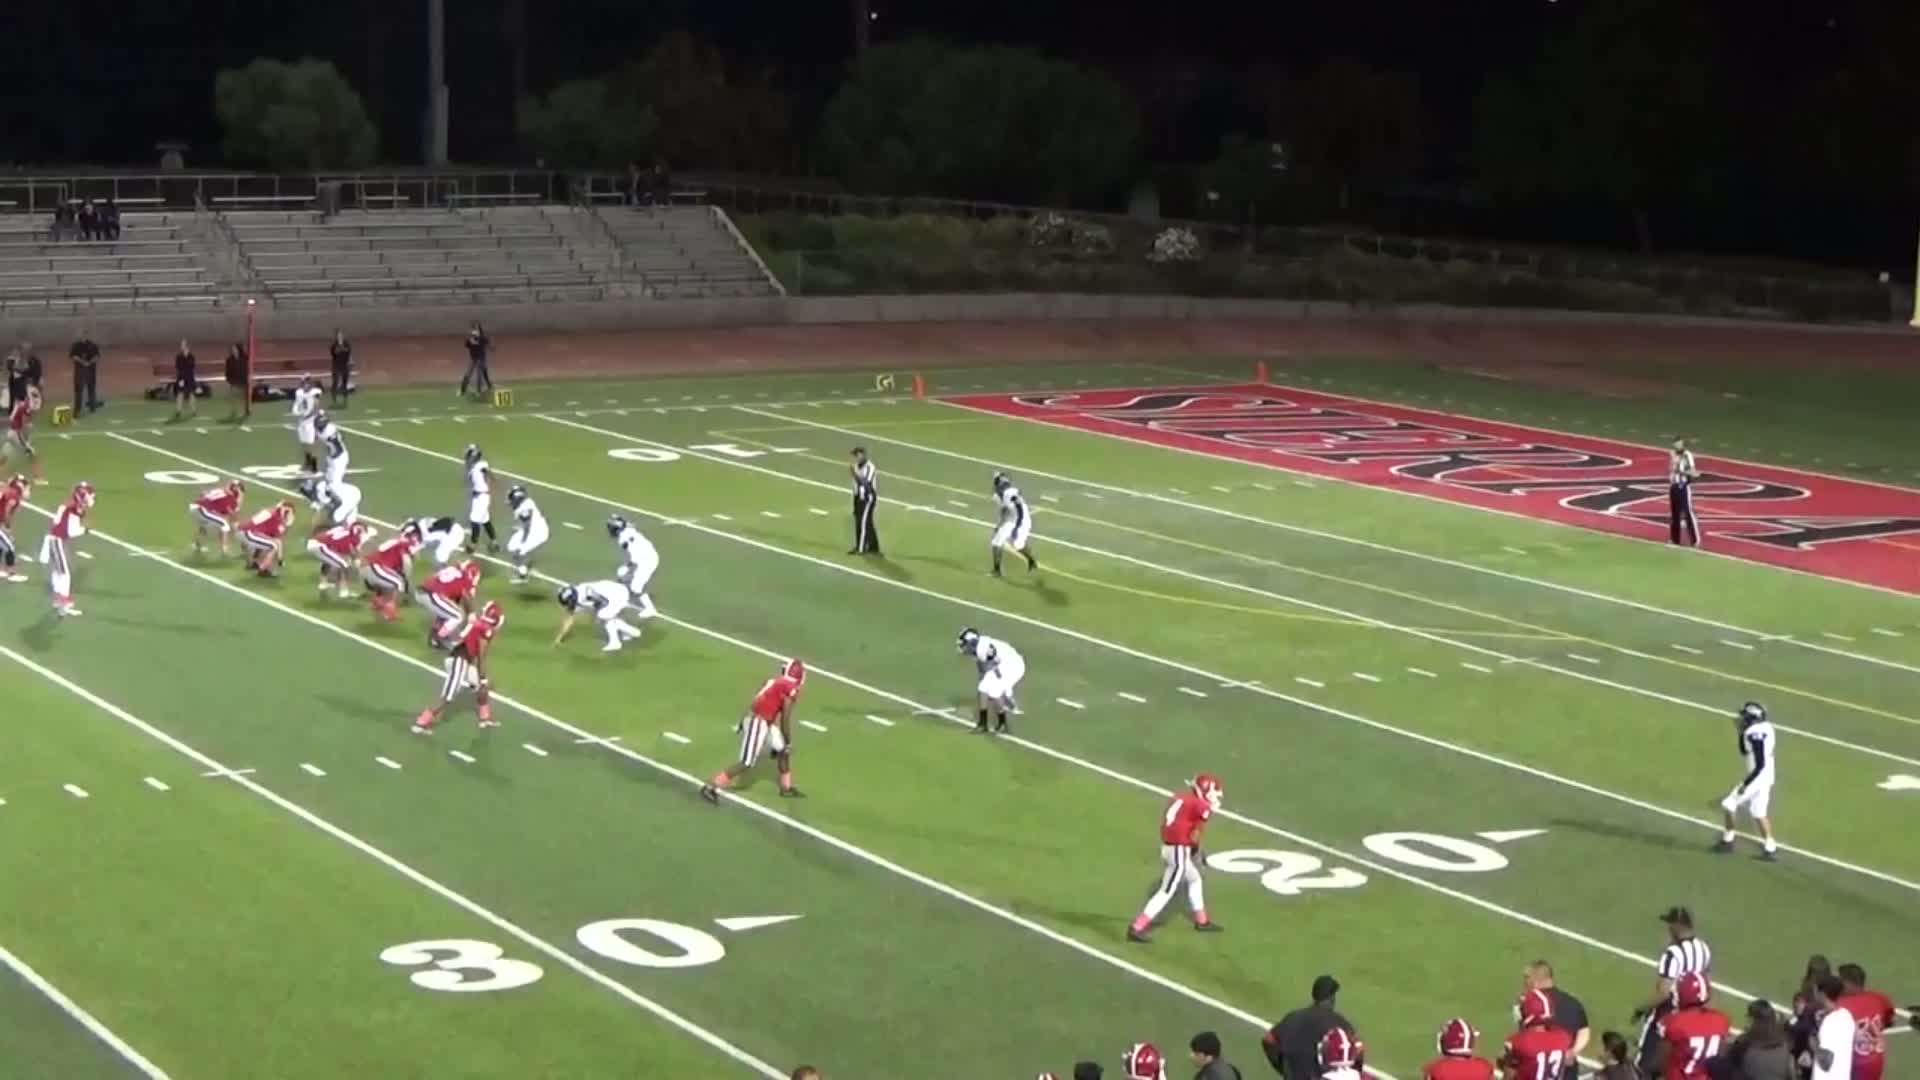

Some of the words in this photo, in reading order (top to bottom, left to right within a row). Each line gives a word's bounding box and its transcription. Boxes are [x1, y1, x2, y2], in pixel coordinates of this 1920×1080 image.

[1012, 392, 1920, 551] SIERRA
[1205, 832, 1510, 895] 20
[379, 918, 727, 992] 30
